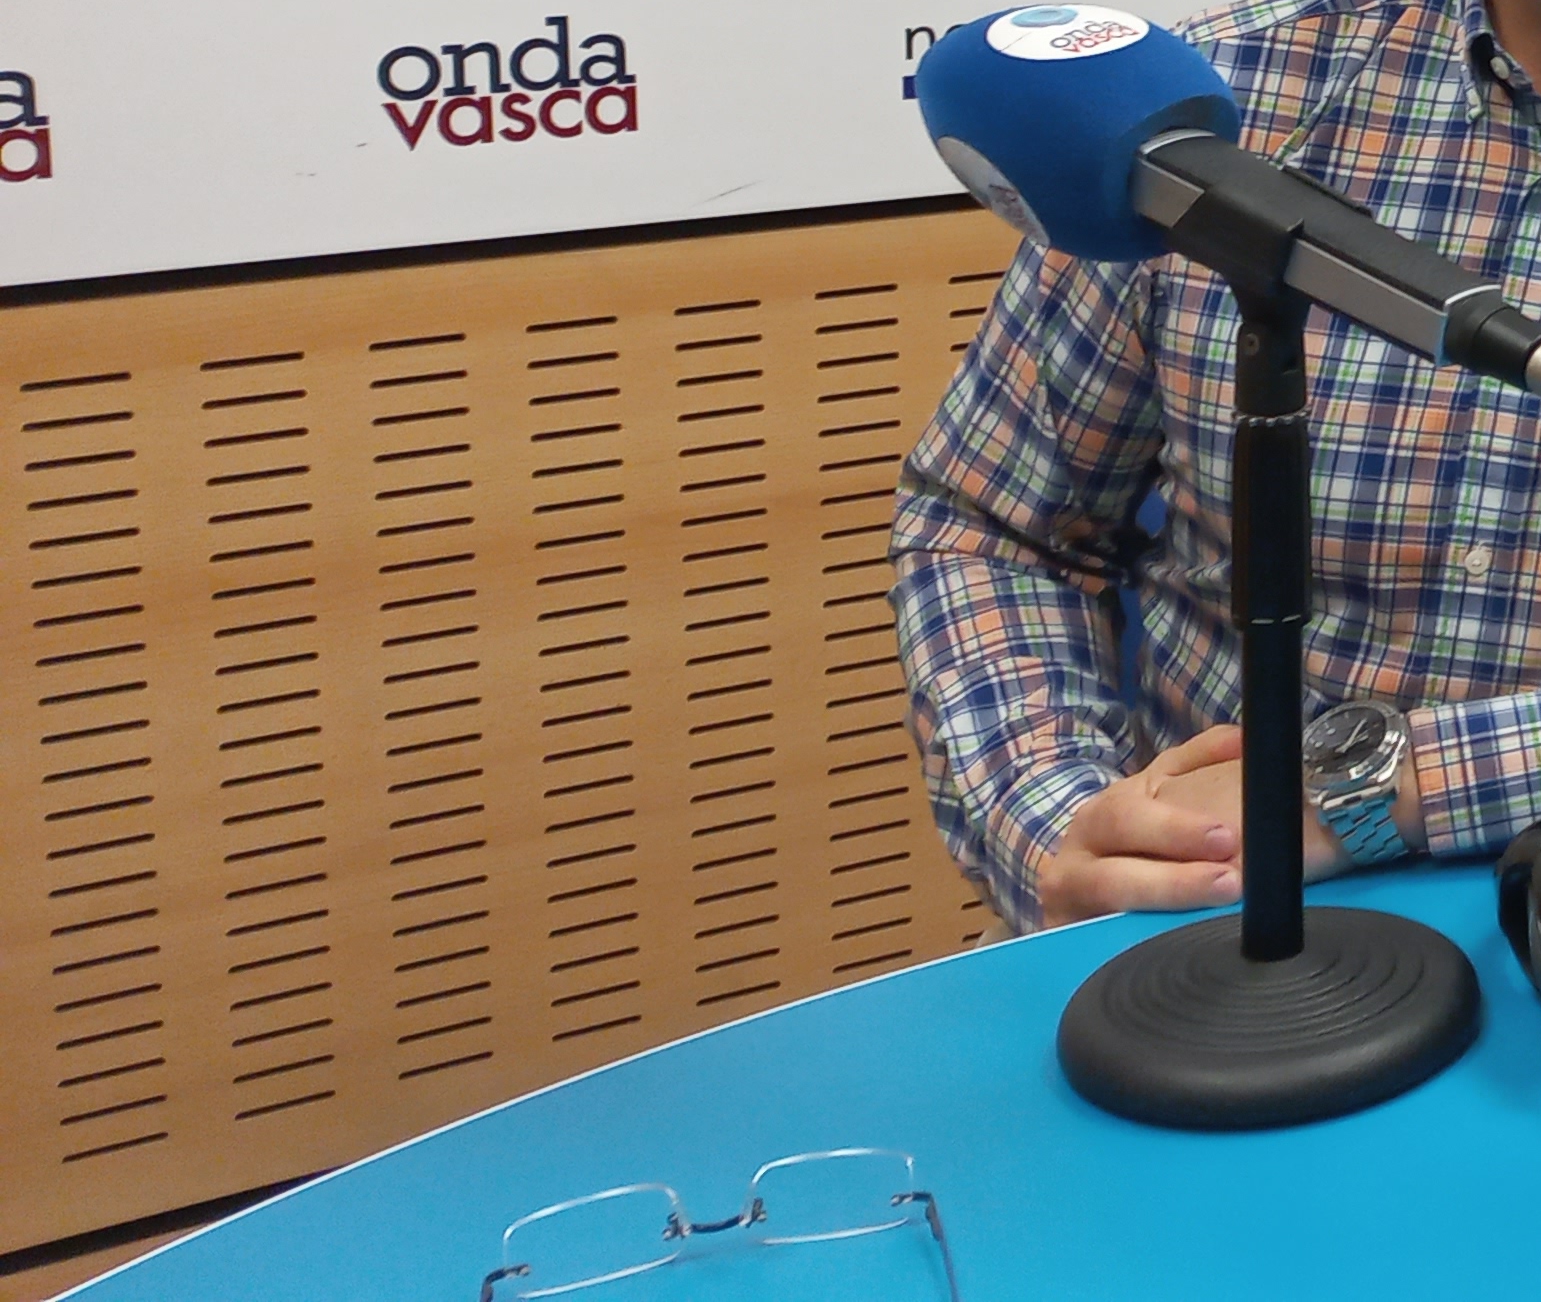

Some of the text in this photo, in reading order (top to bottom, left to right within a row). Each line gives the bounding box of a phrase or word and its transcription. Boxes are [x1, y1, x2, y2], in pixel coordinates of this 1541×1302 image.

[377, 15, 637, 100] onda
[1049, 19, 1126, 49] onda
[1062, 25, 1140, 54] vasca
[384, 84, 639, 150] vasca
